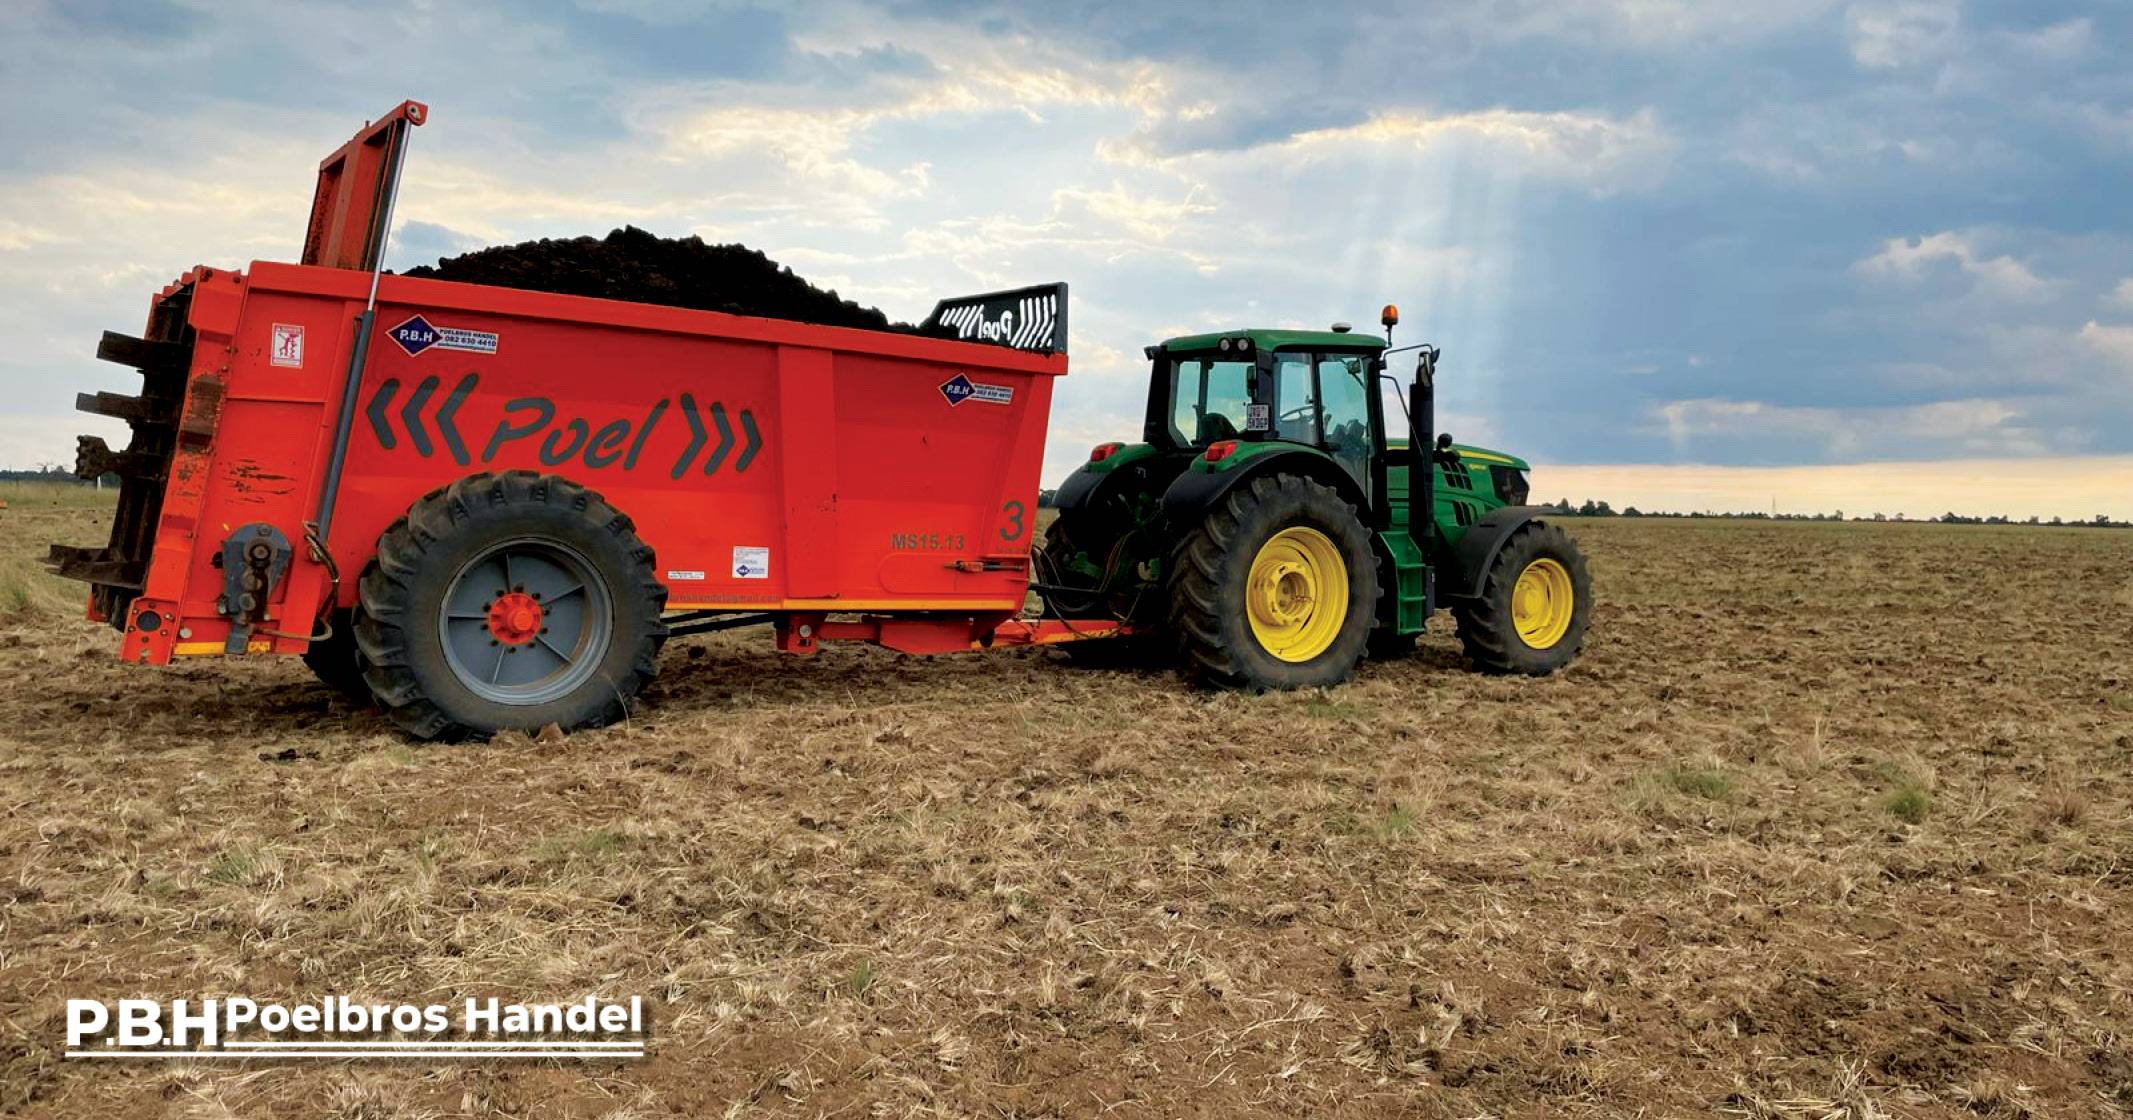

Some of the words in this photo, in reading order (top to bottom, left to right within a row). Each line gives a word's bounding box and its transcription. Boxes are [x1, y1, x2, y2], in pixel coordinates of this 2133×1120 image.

[400, 329, 433, 342] P.B.H
[946, 384, 970, 395] P.B.H
[481, 397, 669, 471] Poel
[1000, 500, 1025, 542] 3
[891, 533, 965, 550] MS15.13
